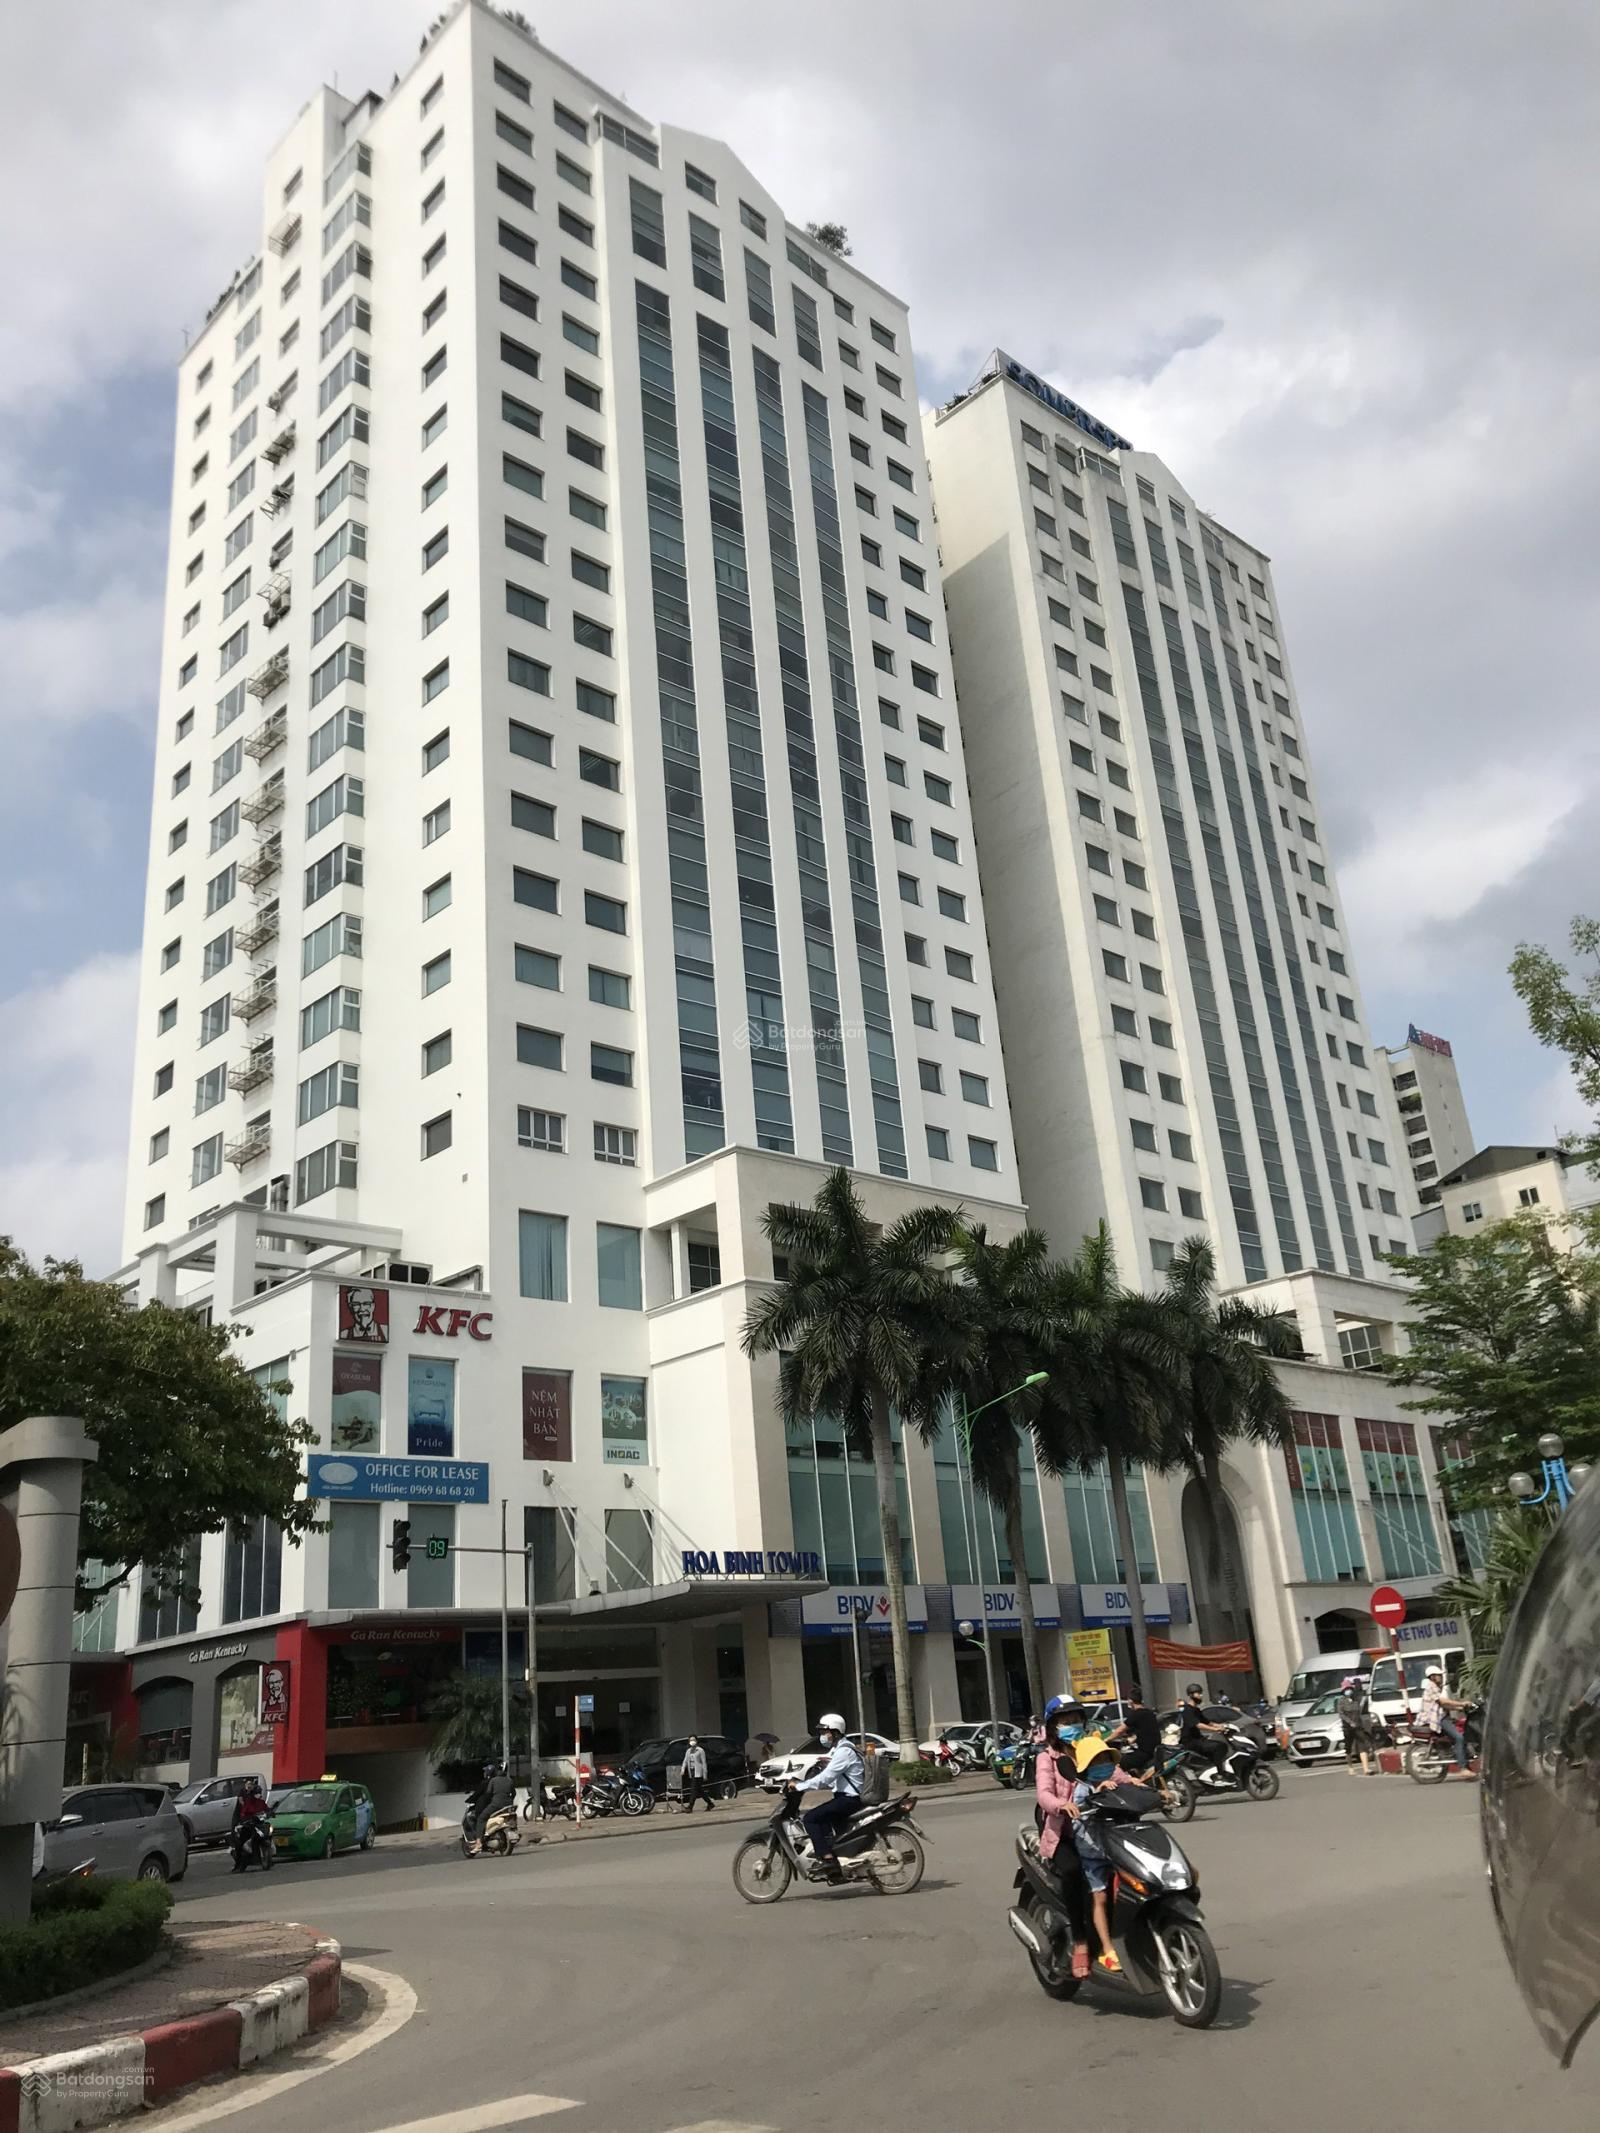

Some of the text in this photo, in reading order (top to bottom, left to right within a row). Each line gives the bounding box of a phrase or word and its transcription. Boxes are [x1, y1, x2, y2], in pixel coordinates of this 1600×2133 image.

[412, 1305, 492, 1341] KFC
[531, 1390, 557, 1404] NỆM
[416, 1438, 443, 1448] Pride
[365, 1463, 479, 1480] OFFICE FOR LEASE
[370, 1482, 475, 1496] Hotline: 0969 68 68 20
[429, 1540, 445, 1556] 09
[682, 1551, 720, 1574] HOA
[723, 1551, 764, 1574] BINH
[837, 1595, 875, 1615] BIDV
[984, 1593, 1015, 1611] BIDV
[392, 1628, 440, 1642] Kentucky
[214, 1643, 248, 1659] Kentucky
[263, 1712, 286, 1722] KFC
